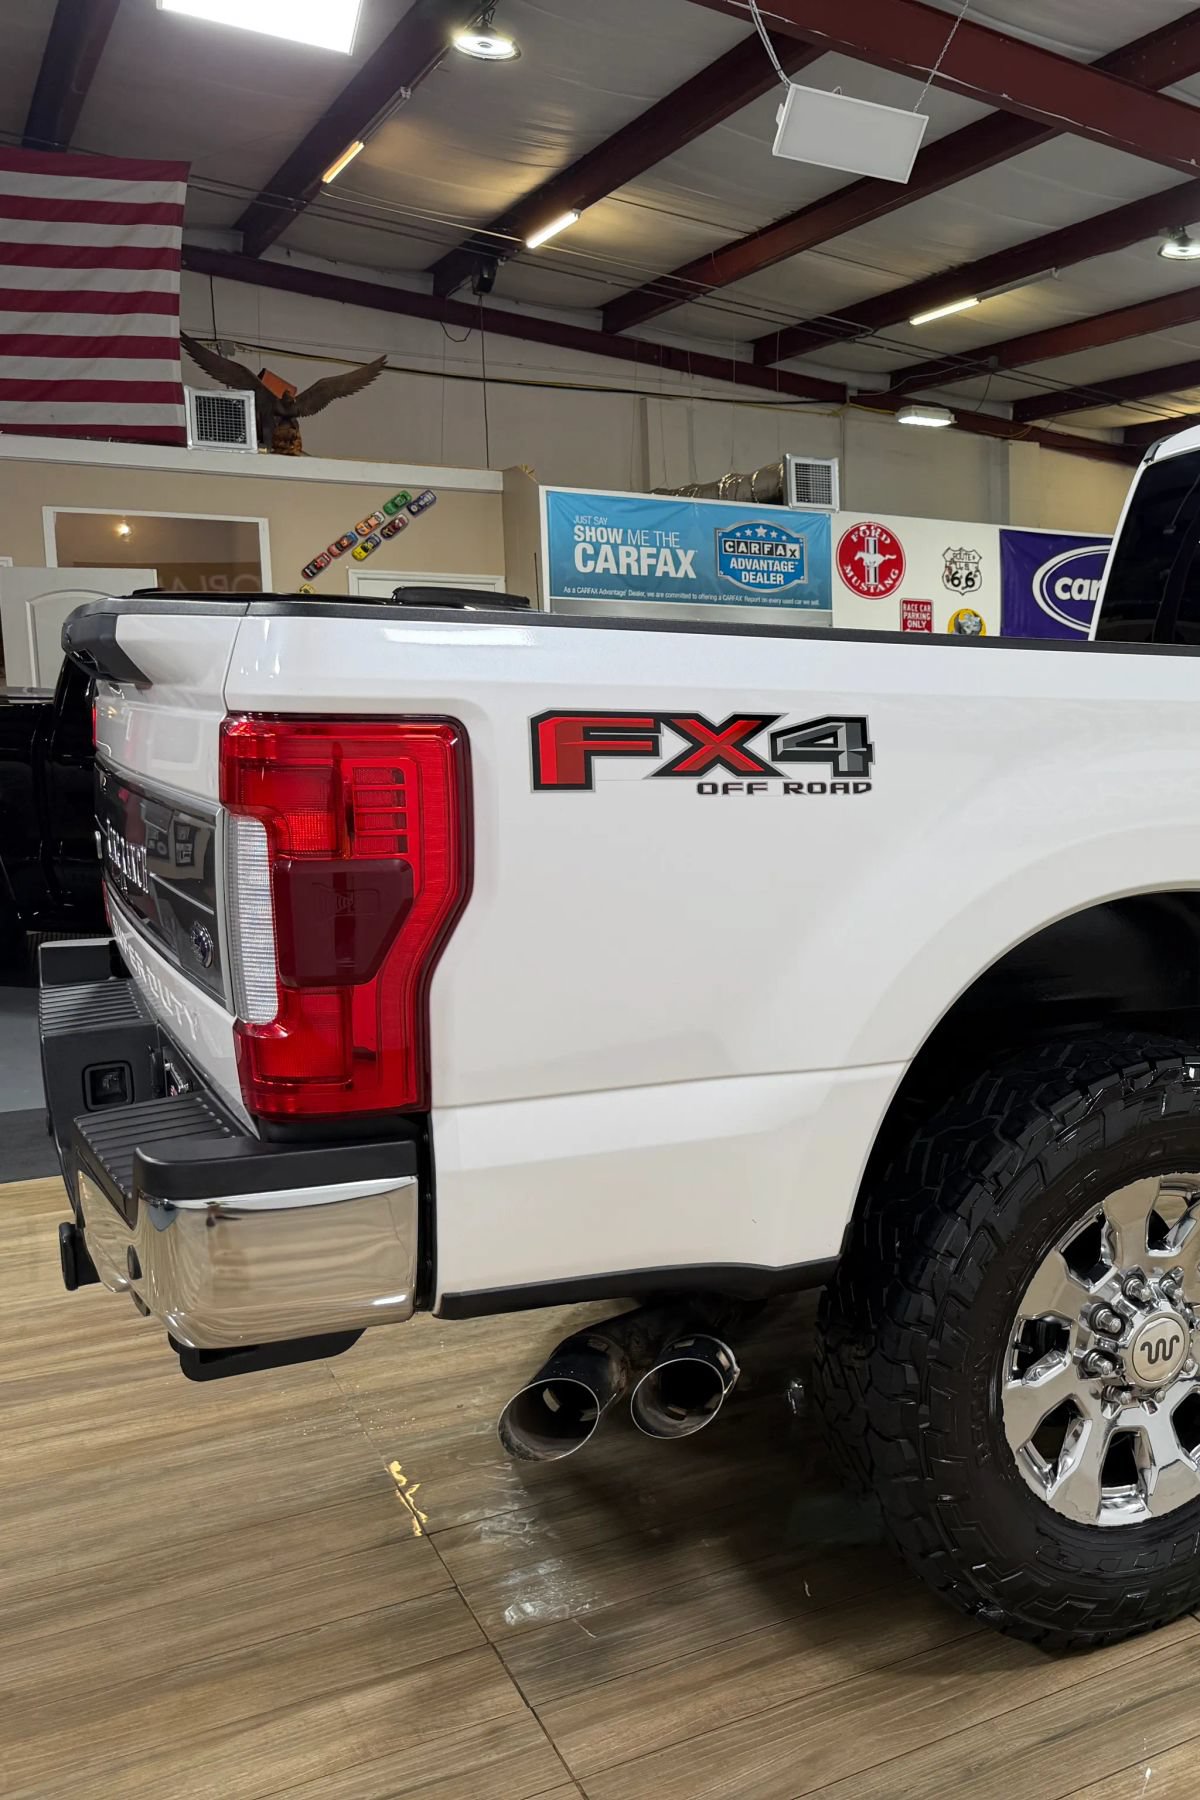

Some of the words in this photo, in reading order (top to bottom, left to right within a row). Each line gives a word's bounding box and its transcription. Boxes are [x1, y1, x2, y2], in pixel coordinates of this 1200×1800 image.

[574, 515, 592, 525] JUST
[593, 516, 608, 525] SAY
[573, 525, 623, 544] SHOW
[627, 529, 650, 546] ME
[653, 530, 680, 548] THE
[850, 525, 891, 545] FORD
[724, 540, 798, 558] CARFAX
[952, 551, 972, 562] ROUTE
[574, 542, 697, 579] CARFAX
[729, 557, 795, 573] ADVANTAGE
[741, 571, 785, 585] DEALER
[844, 564, 899, 592] MUSTANG
[950, 570, 976, 590] 66
[903, 603, 918, 612] RACE
[919, 604, 931, 612] CAR
[903, 612, 931, 621] PARKING
[907, 620, 927, 629] ONLY
[527, 707, 875, 793] FX4
[696, 781, 769, 796] OFF
[782, 781, 873, 796] ROAD
